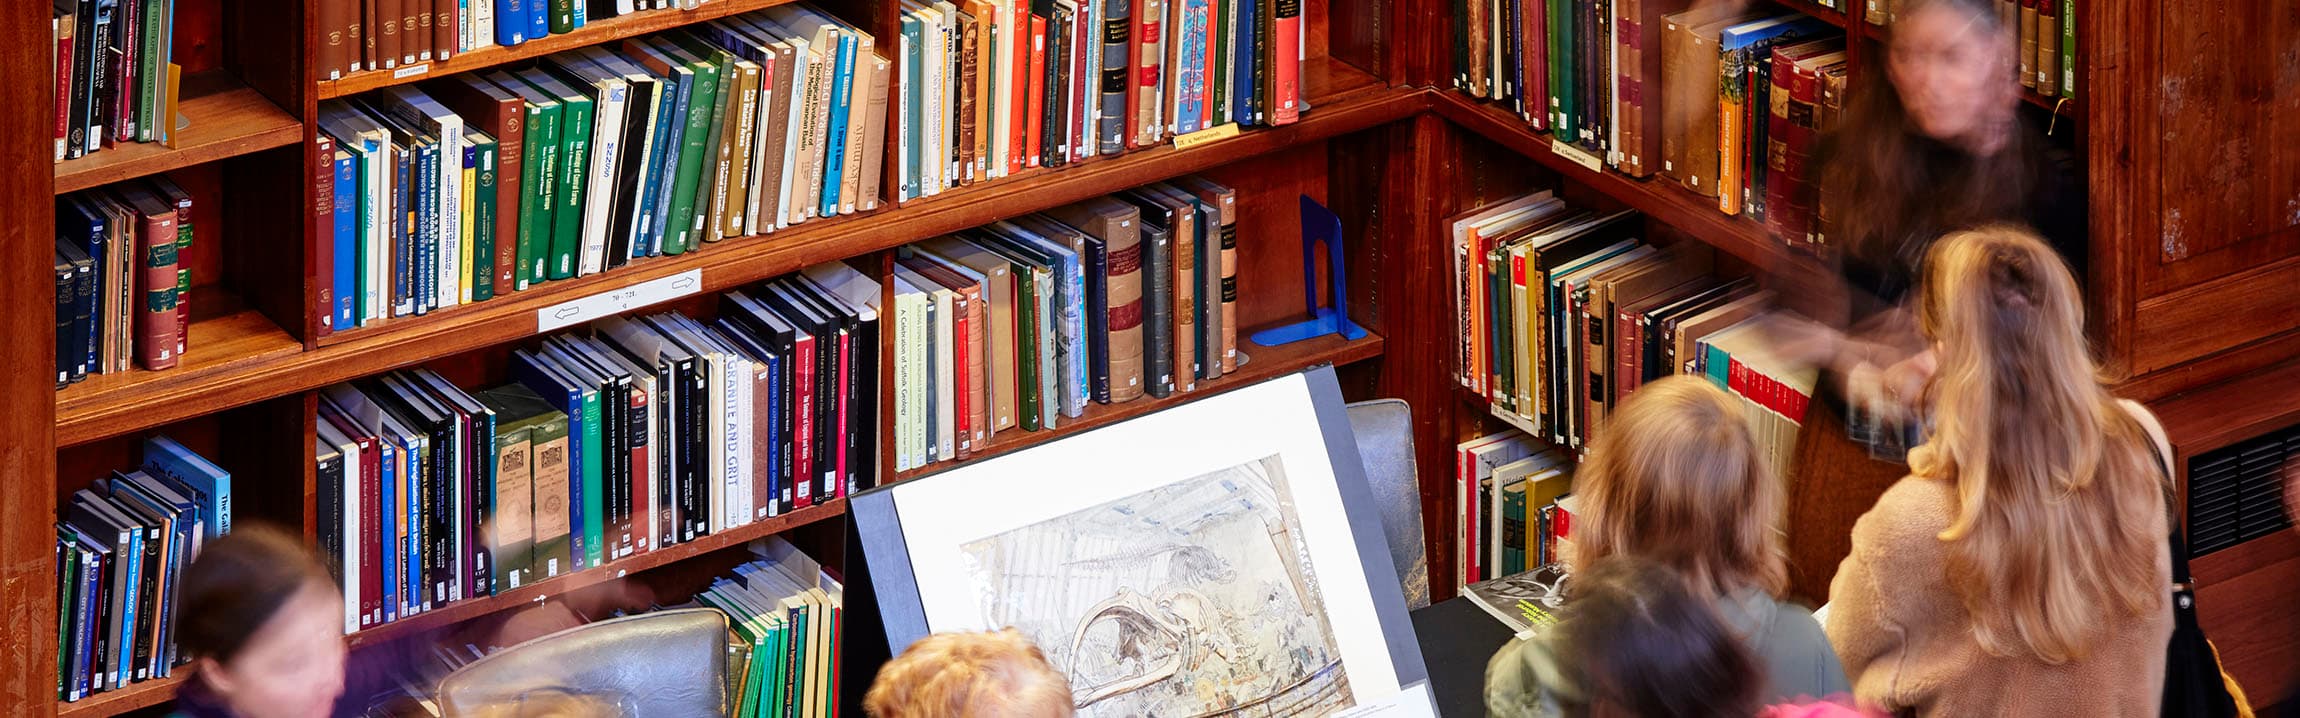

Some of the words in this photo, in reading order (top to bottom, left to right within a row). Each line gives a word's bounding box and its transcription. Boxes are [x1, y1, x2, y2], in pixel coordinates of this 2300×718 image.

[812, 62, 823, 101] Geological
[821, 46, 835, 101] D'EUROPA
[802, 76, 813, 128] Mediterranean
[808, 102, 818, 136] Evolution
[814, 104, 828, 157] NATURALE
[800, 130, 808, 151] Basin
[807, 137, 814, 146] of
[1193, 131, 1221, 143] Netherlands
[574, 149, 582, 167] Geology
[571, 173, 579, 189] Central
[809, 159, 821, 197] STORIA
[569, 189, 577, 205] Europe
[899, 317, 907, 353] Celebration
[727, 360, 736, 417] GRANITE
[899, 364, 907, 386] Suffolk
[727, 422, 736, 451] AND
[727, 456, 737, 485] GRIT
[219, 495, 229, 510] The
[789, 613, 799, 649] Carboniferous
[787, 650, 796, 682] hydrocarbon
[786, 683, 794, 704] geology
